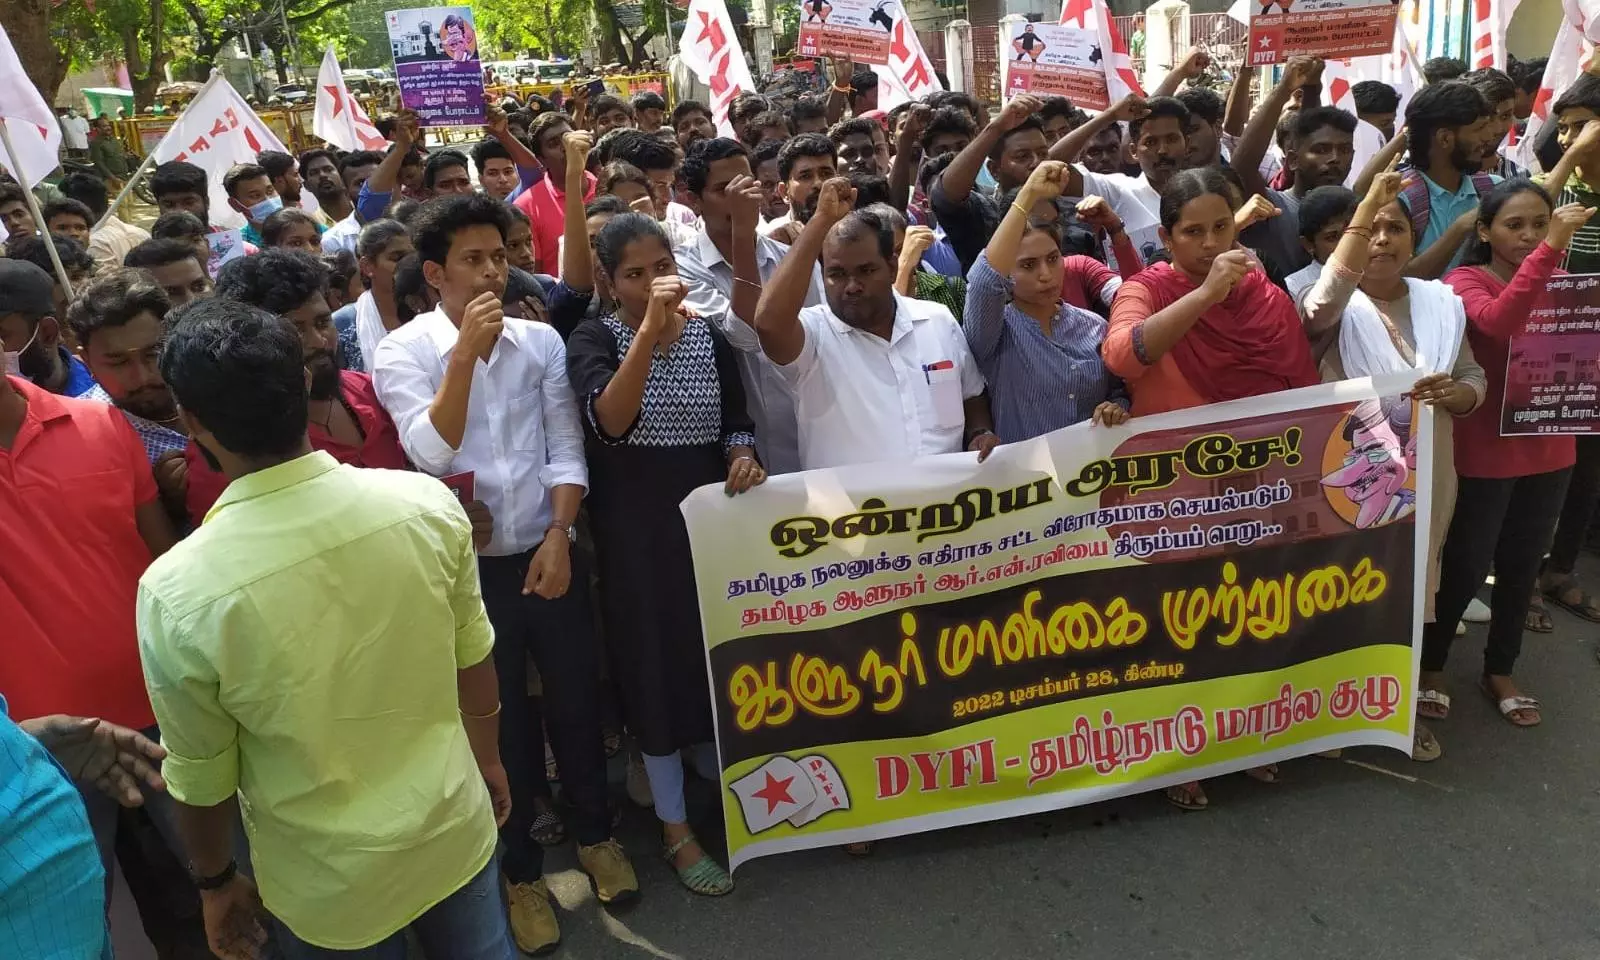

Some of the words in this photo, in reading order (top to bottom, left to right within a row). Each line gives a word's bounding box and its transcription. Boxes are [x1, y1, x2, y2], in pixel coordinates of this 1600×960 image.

[1253, 51, 1276, 63] DYFI
[1514, 407, 1556, 423] முற்றுகை
[727, 571, 806, 600] தமிழக
[811, 551, 912, 590] நலனுக்கு
[917, 541, 994, 568] எதிராக
[998, 528, 1038, 552] சட்ட
[1043, 502, 1165, 541] விரோதமாக
[1170, 479, 1291, 518] செயல்படும்
[770, 476, 1053, 558] ஒன்றிய
[1065, 427, 1303, 497] அரசே!
[741, 600, 827, 629] தமிழக
[833, 573, 926, 613] ஆளுநர்
[934, 541, 1108, 593] ஆர்.என்.ரவியை
[1114, 525, 1205, 558] திரும்பப்
[1209, 521, 1281, 545] பெறு...
[728, 611, 928, 731] ஆளுநர்
[937, 589, 1148, 677] மாளிகை
[1162, 557, 1387, 650] முற்றுகை
[952, 691, 1005, 717] 2022
[1010, 671, 1079, 704] டிசம்பர்
[1086, 668, 1119, 687] 28,
[1124, 660, 1185, 683] கிண்டி
[808, 759, 841, 807] DYFI
[874, 737, 999, 798] DYFI
[1004, 755, 1021, 768] -
[1028, 705, 1207, 787] தமிழ்நாடு
[1215, 682, 1322, 743] மாநில
[1329, 675, 1400, 721] குழு
